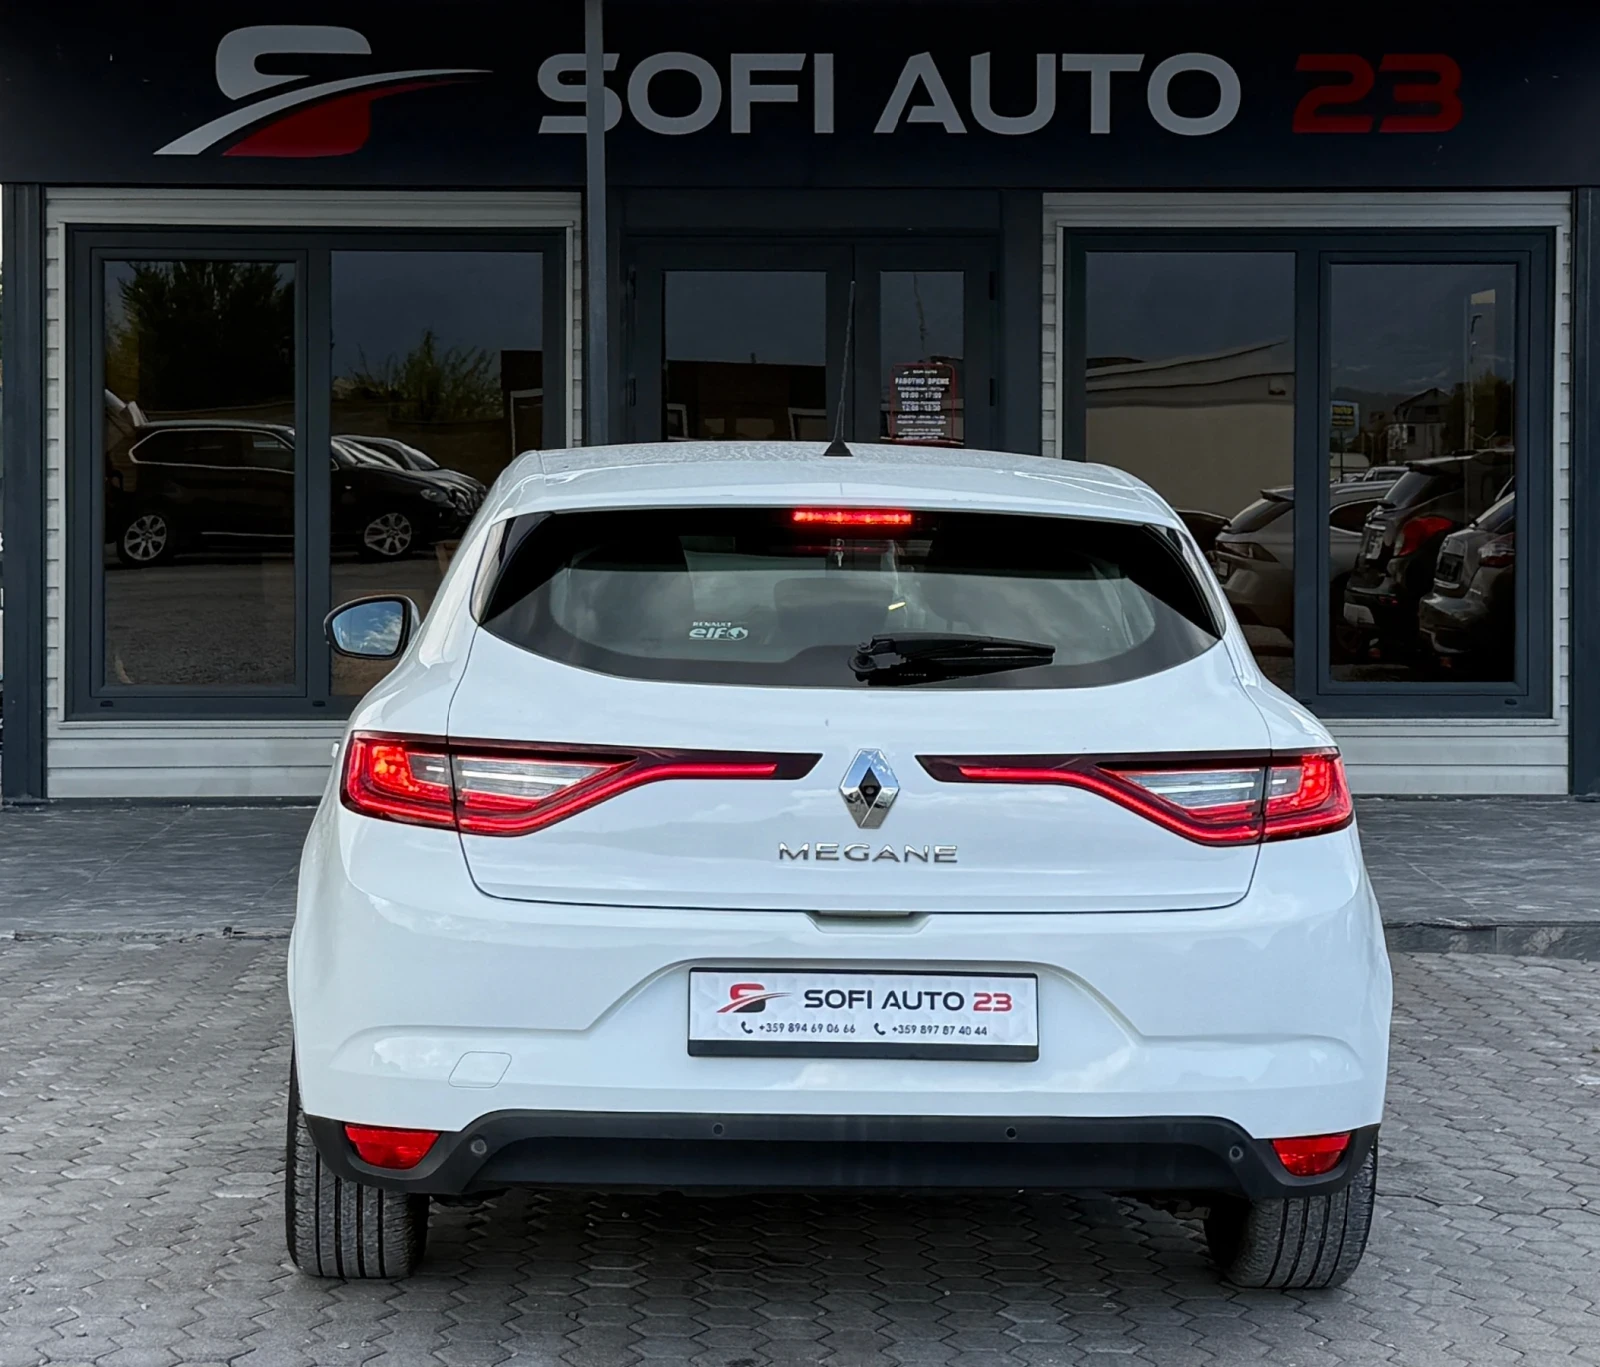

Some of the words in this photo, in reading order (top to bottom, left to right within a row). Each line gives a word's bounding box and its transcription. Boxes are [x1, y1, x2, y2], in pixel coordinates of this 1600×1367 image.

[538, 52, 834, 136] SOFI
[874, 51, 1241, 136] AUTO
[1292, 53, 1463, 134] 23
[778, 842, 959, 864] MEGANE
[803, 989, 873, 1010] SOFI
[881, 990, 966, 1012] AUTO
[973, 992, 1013, 1012] 23
[759, 1022, 785, 1033] +359
[787, 1022, 808, 1033] 894
[810, 1023, 824, 1033] 69
[826, 1023, 840, 1034] 06
[843, 1024, 856, 1034] 66
[892, 1024, 917, 1034] +359
[920, 1024, 940, 1035] 897
[942, 1025, 956, 1036] 87
[958, 1025, 972, 1036] 40
[974, 1026, 988, 1036] 44
